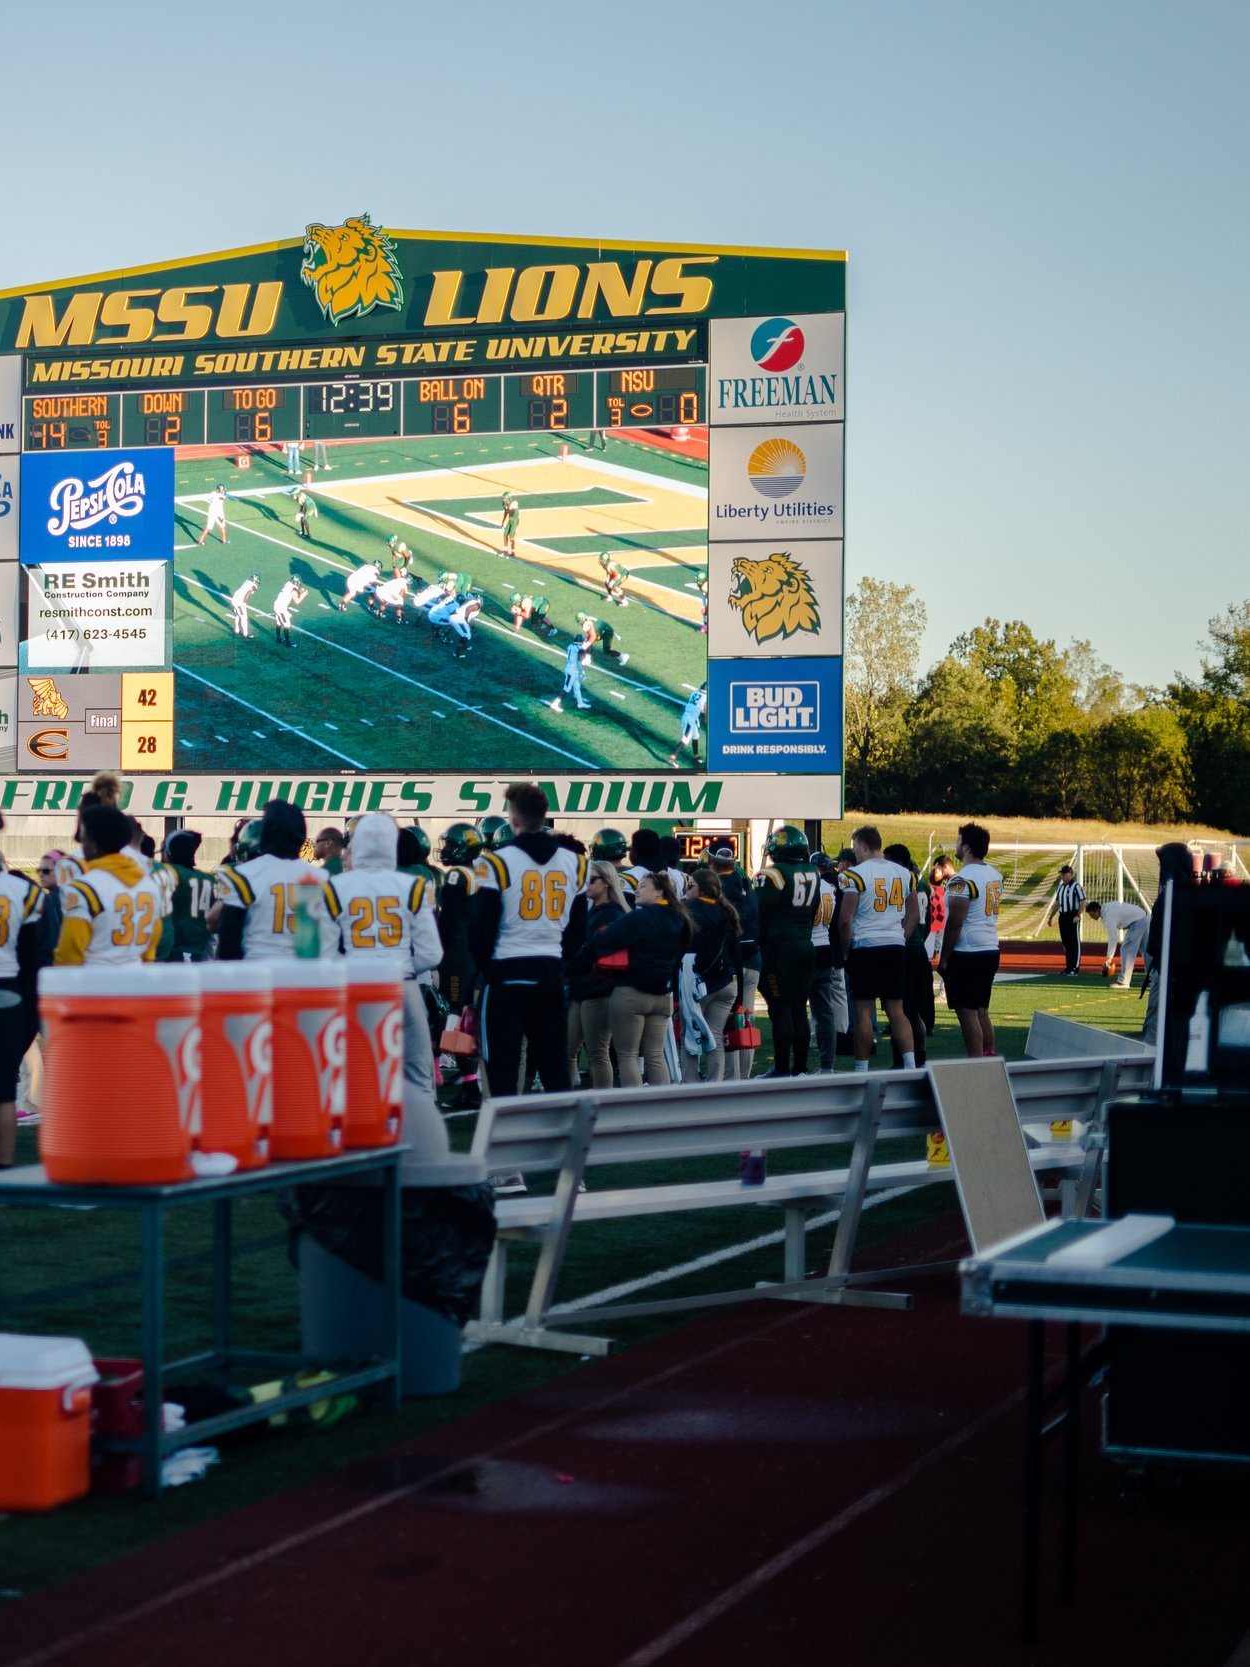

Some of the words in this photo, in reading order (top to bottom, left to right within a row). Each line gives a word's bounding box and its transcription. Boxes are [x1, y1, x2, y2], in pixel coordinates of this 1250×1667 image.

[423, 256, 719, 326] LIONS
[15, 281, 284, 348] MSSU
[33, 355, 184, 383] MISSOURI
[193, 345, 366, 375] SOUTHERN
[375, 340, 477, 366] STATE
[486, 329, 697, 359] UNIVERSITY
[419, 380, 458, 402] BALL
[463, 378, 484, 399] ON
[532, 375, 565, 396] QTR
[621, 370, 654, 392] NSU
[718, 374, 837, 409] FREEMAN
[33, 396, 108, 418] SOUTHERN
[143, 392, 182, 414] DOWN
[232, 389, 251, 410] TO
[256, 388, 277, 409] GO
[322, 381, 393, 413] 12:39
[608, 398, 623, 407] TOL
[679, 392, 698, 424] 0
[453, 403, 470, 433] 6
[550, 399, 567, 429] 2
[610, 408, 622, 427] 3
[775, 409, 803, 419] Health
[806, 408, 837, 419] System
[41, 422, 66, 449] 14
[95, 420, 110, 430] TOL
[164, 416, 181, 446] 2
[255, 412, 271, 442] 6
[97, 430, 108, 448] 3
[716, 504, 769, 521] Liberty
[774, 502, 834, 517] Utilities
[68, 535, 102, 548] SINCE
[105, 534, 131, 547] 1898
[44, 573, 76, 590] RE
[82, 571, 150, 589] Smith
[44, 591, 103, 599] Construction
[106, 589, 149, 600] Company
[39, 606, 152, 618] resmithconst.com
[45, 629, 80, 643] (417)
[83, 628, 147, 641] 623-4545
[137, 689, 157, 706] 42
[746, 686, 803, 707] BUD
[91, 714, 118, 728] Final
[137, 736, 157, 754] 28
[722, 745, 755, 754] DRINK
[756, 744, 827, 754] RESPONSIBLY.
[152, 781, 193, 811] G.
[215, 781, 436, 812] HUGHES
[455, 781, 723, 813] SADIUM
[189, 878, 212, 918] 14
[519, 870, 567, 921] 86
[793, 872, 817, 907] 67
[874, 878, 904, 912] 54
[111, 892, 154, 946] 32
[350, 896, 402, 948] 25
